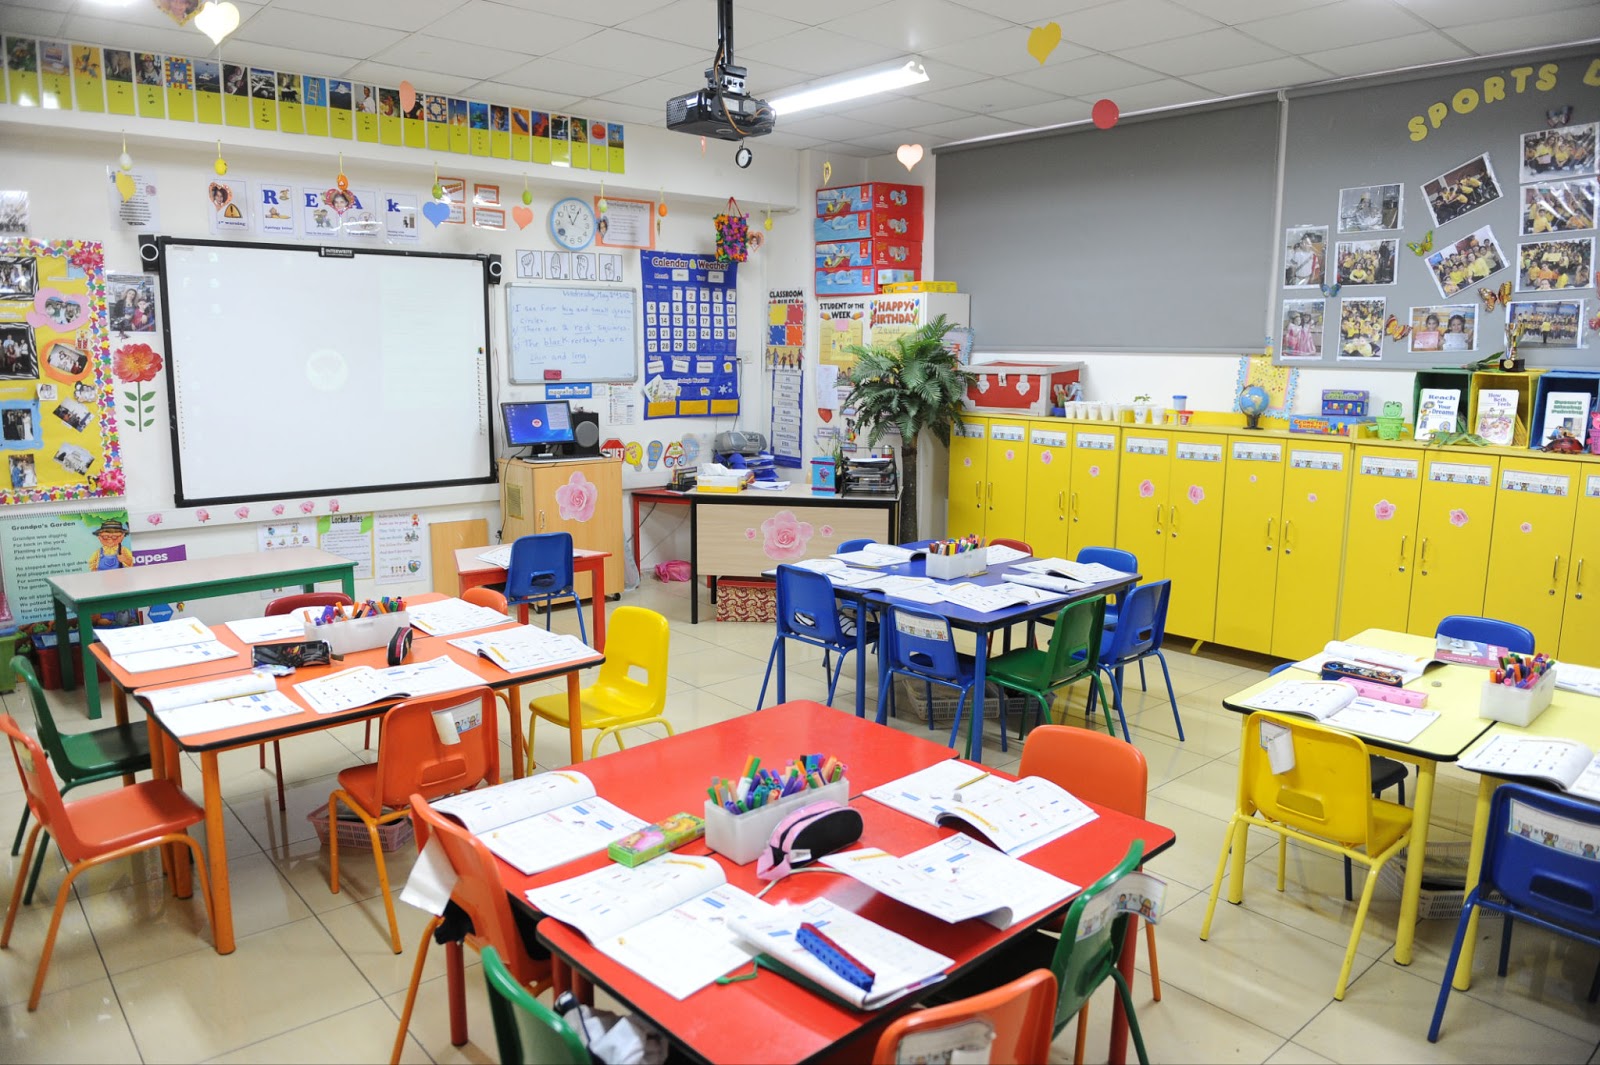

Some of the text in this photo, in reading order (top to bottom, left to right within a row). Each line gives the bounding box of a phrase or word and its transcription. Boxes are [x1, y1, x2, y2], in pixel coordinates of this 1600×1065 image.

[1407, 63, 1560, 142] SPORTS
[262, 190, 279, 204] R
[304, 193, 319, 208] E
[386, 198, 400, 212] k
[652, 256, 729, 271] Calendar & Weather
[769, 290, 803, 298] CLASSROOM
[878, 301, 911, 312] HAPPY
[871, 312, 917, 324] BIRTHDAY
[332, 514, 363, 524] Locker Rules
[11, 523, 48, 531] Grandpa's
